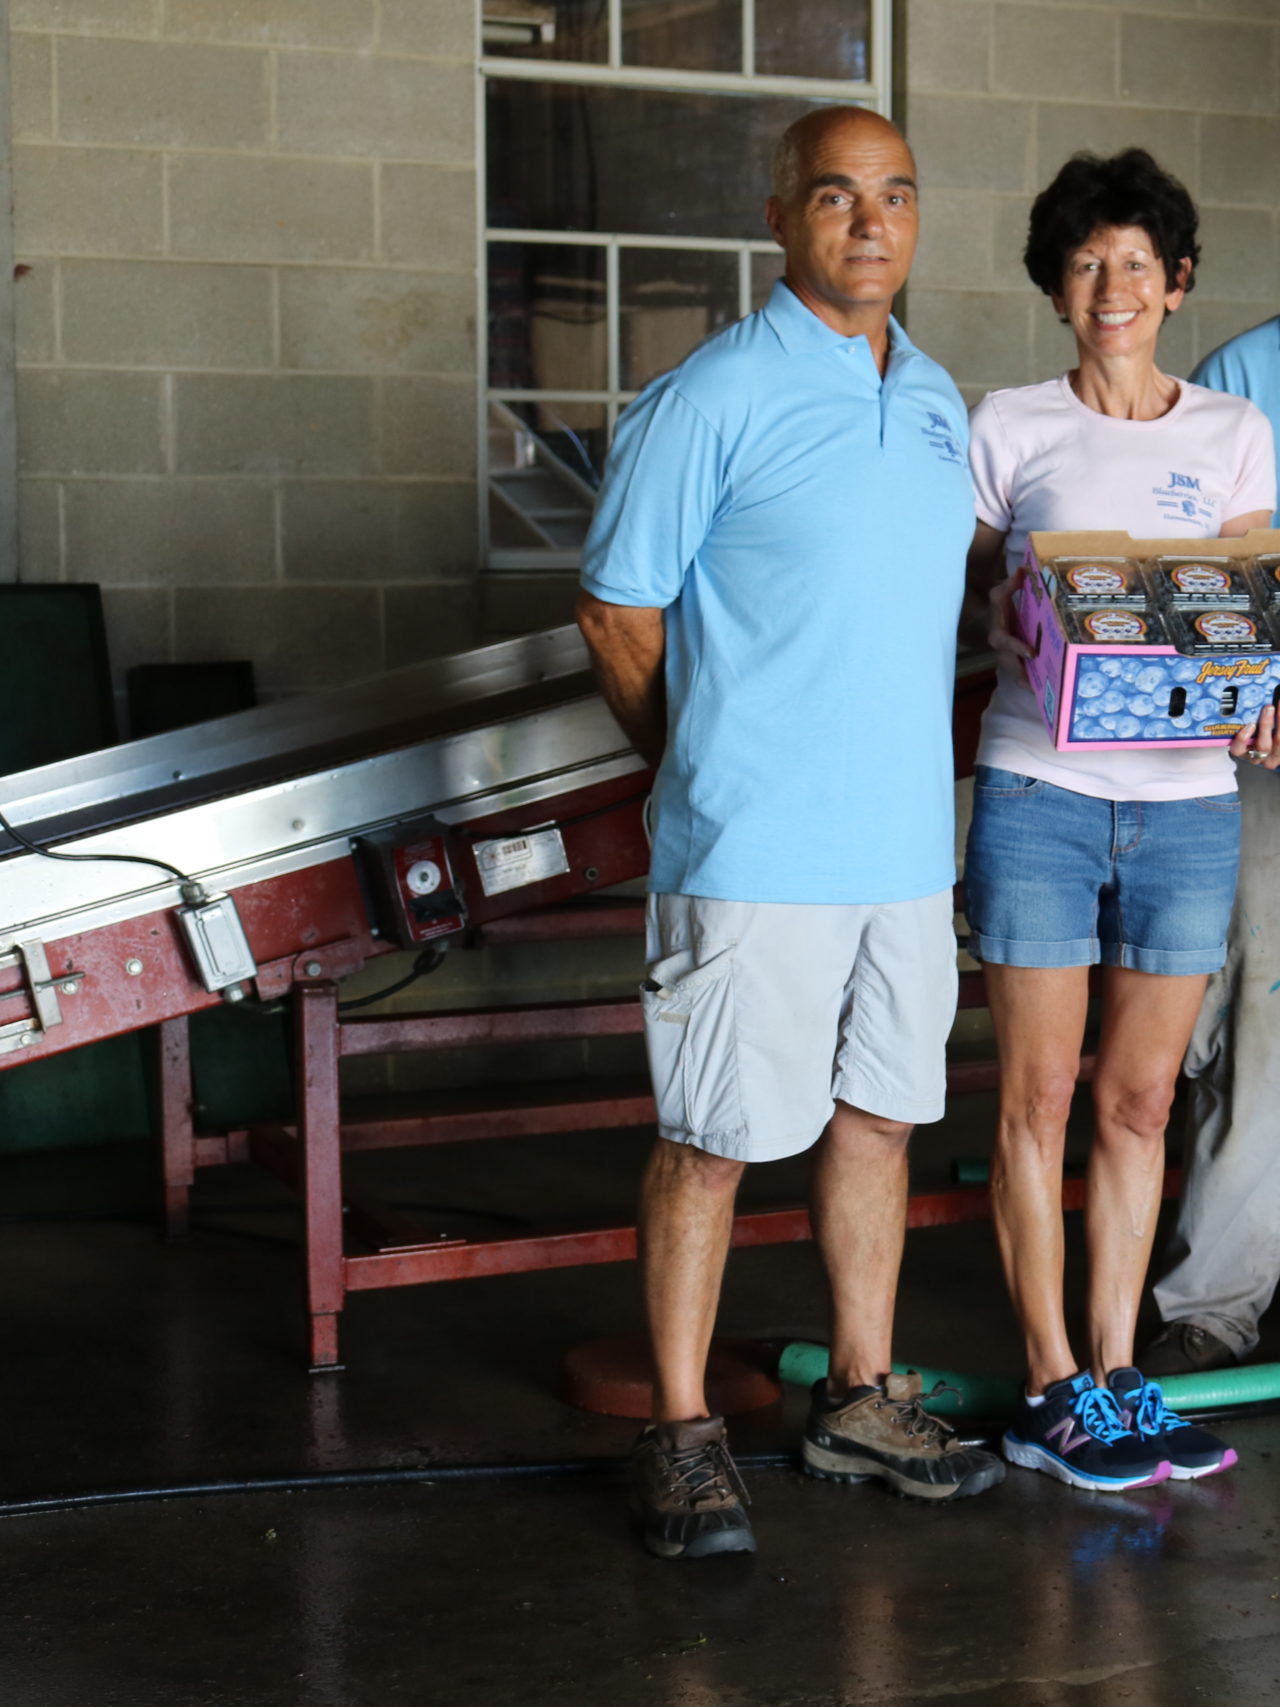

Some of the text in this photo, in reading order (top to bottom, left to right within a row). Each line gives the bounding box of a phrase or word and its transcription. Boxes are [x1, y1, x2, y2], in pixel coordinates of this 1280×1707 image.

[1167, 471, 1202, 492] JSM
[1196, 658, 1271, 684] Jersey Fruit
